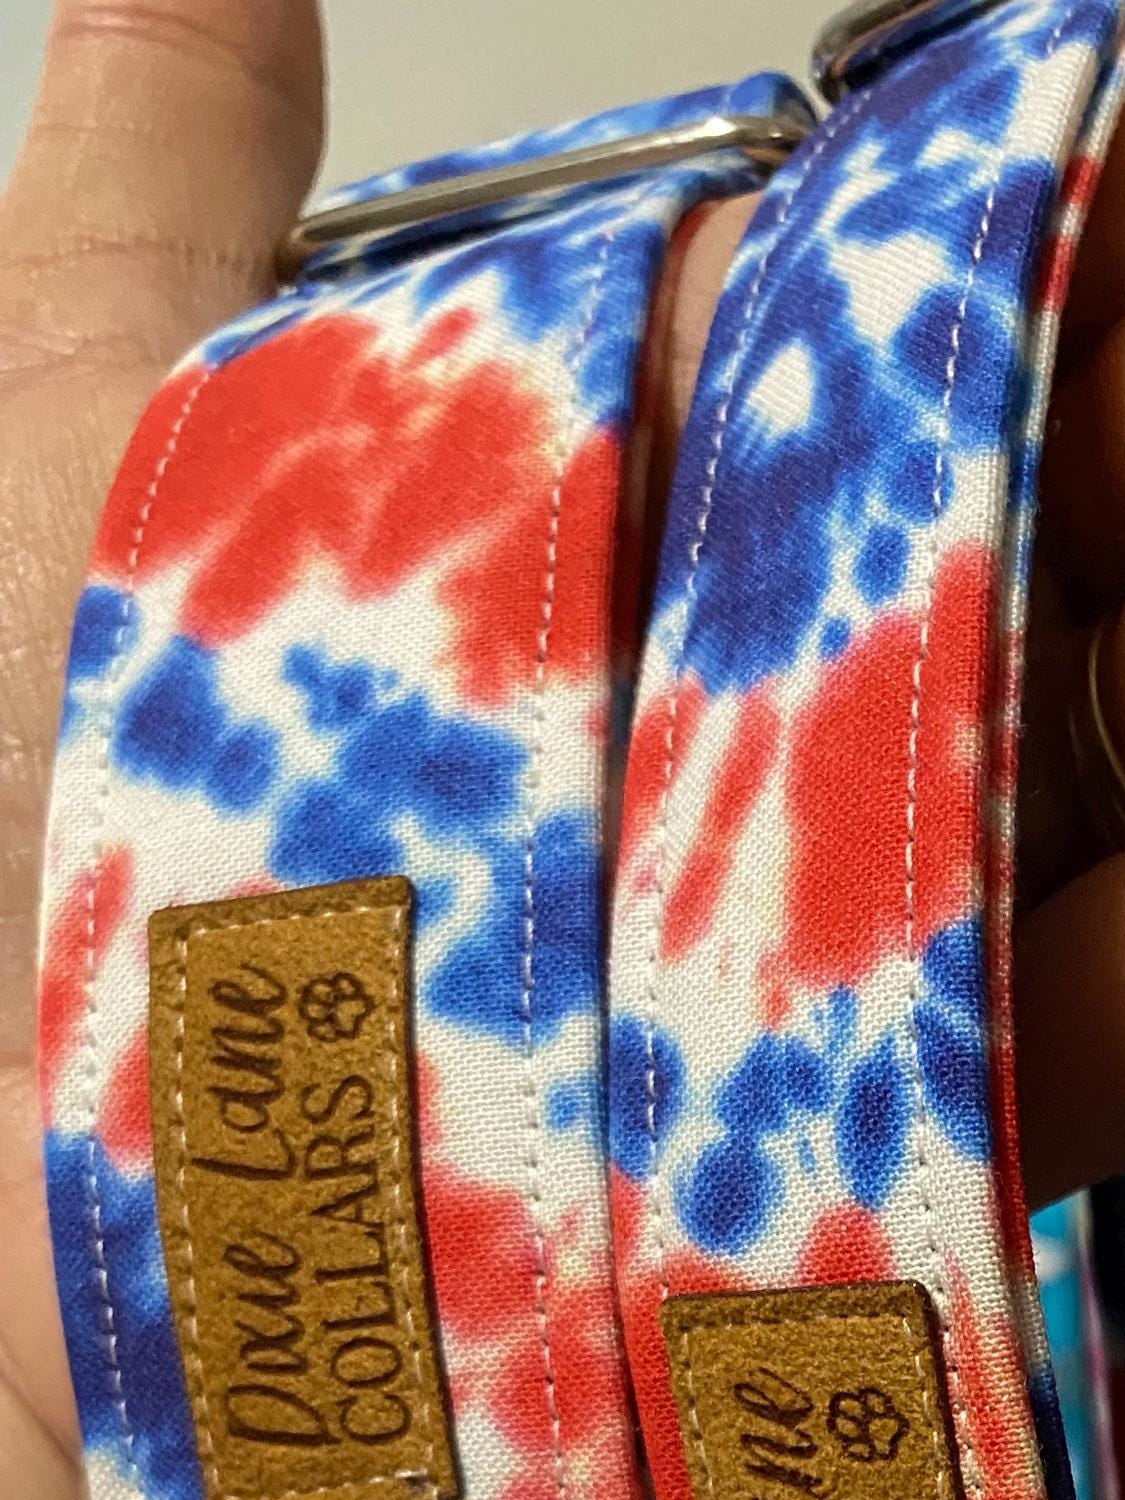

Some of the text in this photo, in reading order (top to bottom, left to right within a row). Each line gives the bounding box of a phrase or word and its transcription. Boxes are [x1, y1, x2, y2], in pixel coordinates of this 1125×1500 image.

[191, 962, 341, 1450] Dixie Lane
[304, 1074, 412, 1446] COLLARS
